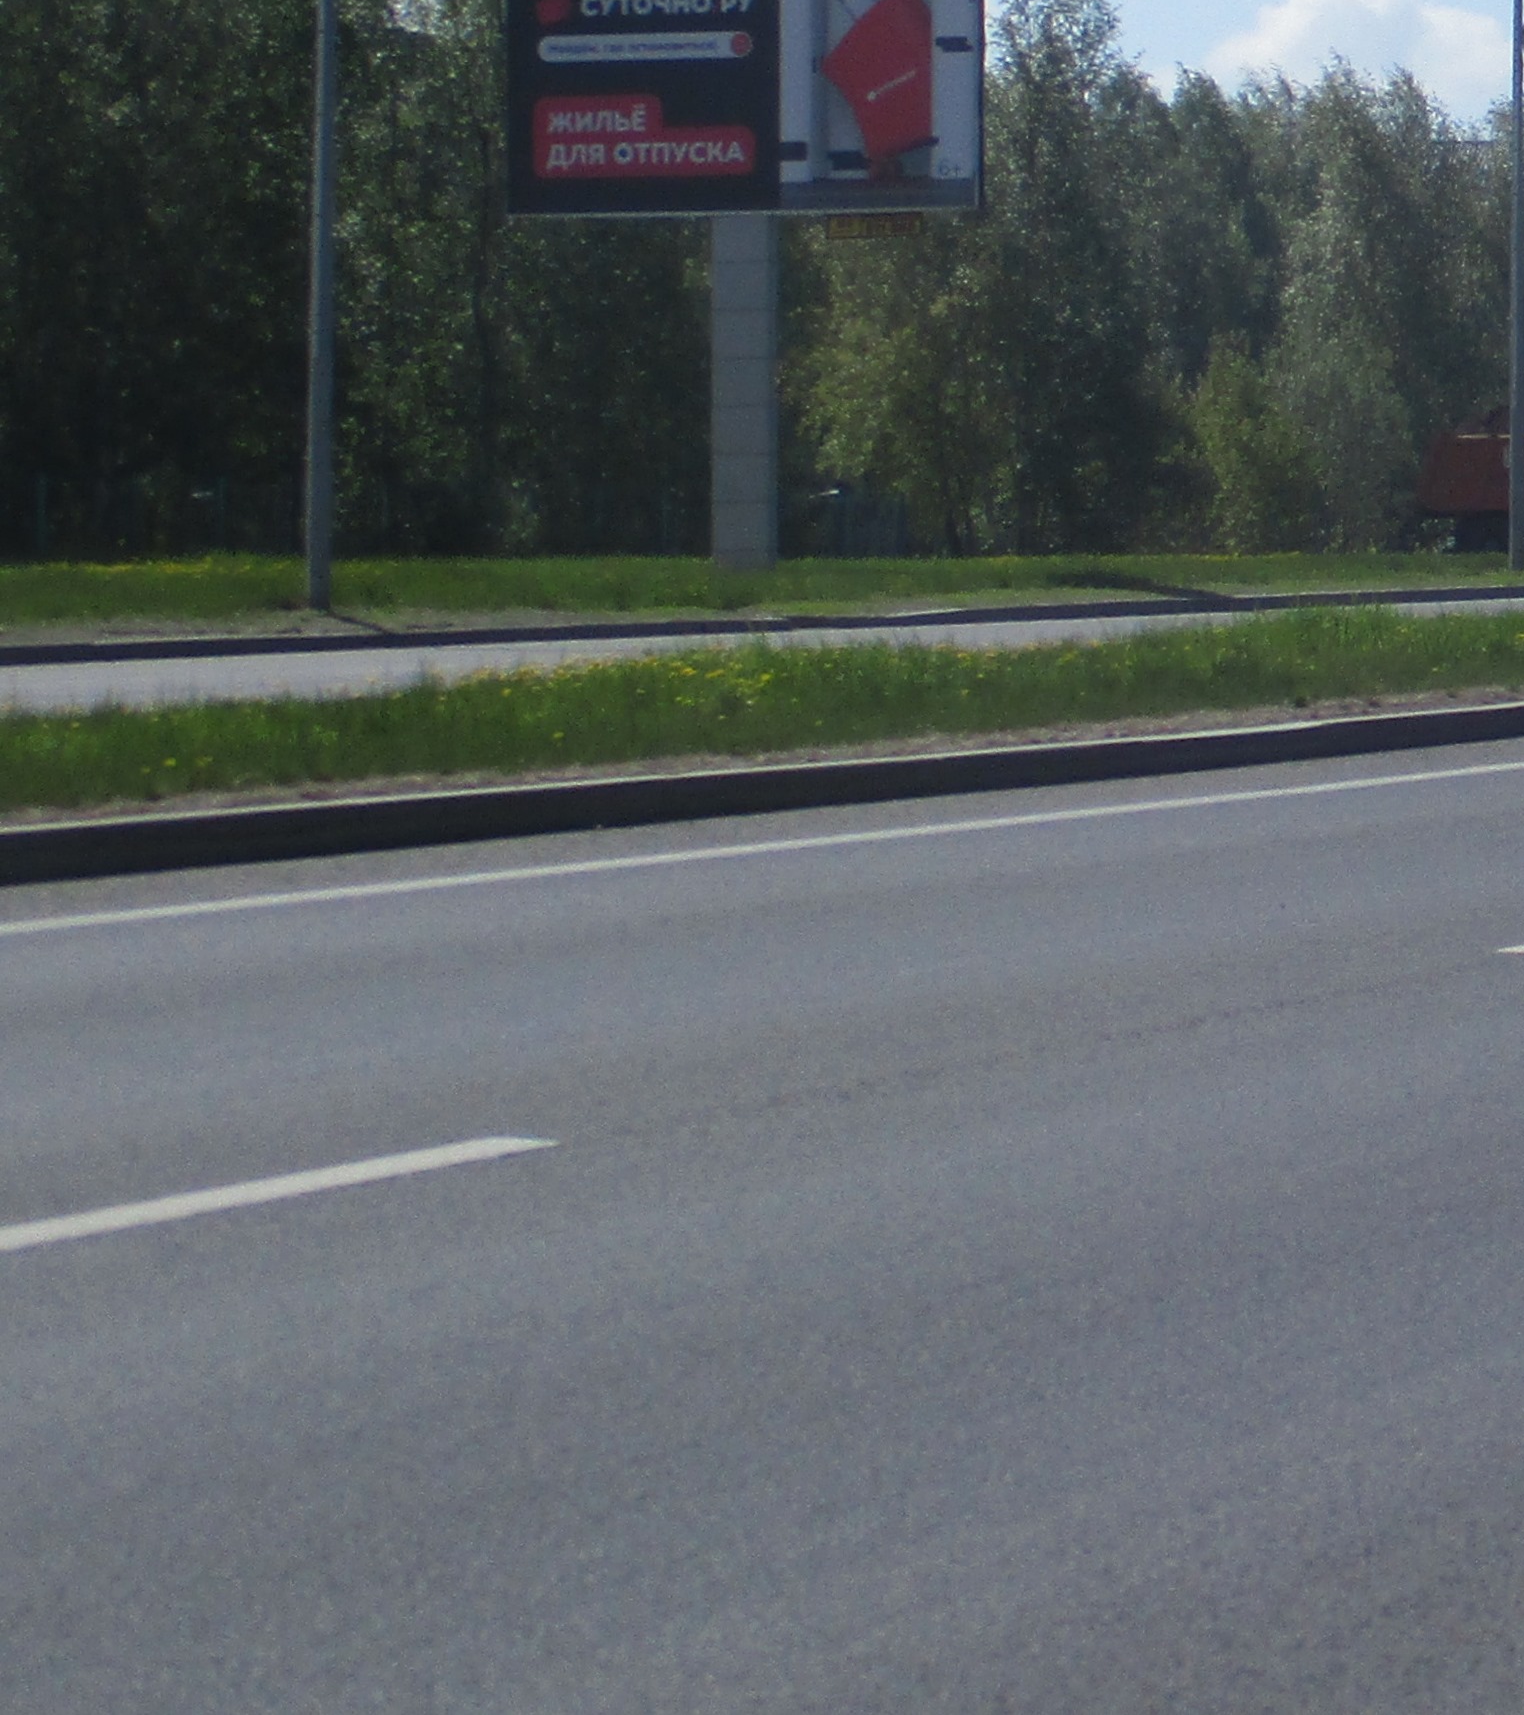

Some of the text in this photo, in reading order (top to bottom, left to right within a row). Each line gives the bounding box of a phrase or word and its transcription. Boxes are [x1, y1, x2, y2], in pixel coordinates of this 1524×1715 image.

[547, 103, 646, 134] ЖИЛЬЁ
[546, 141, 745, 170] ДЛЯ ОТПУСКА
